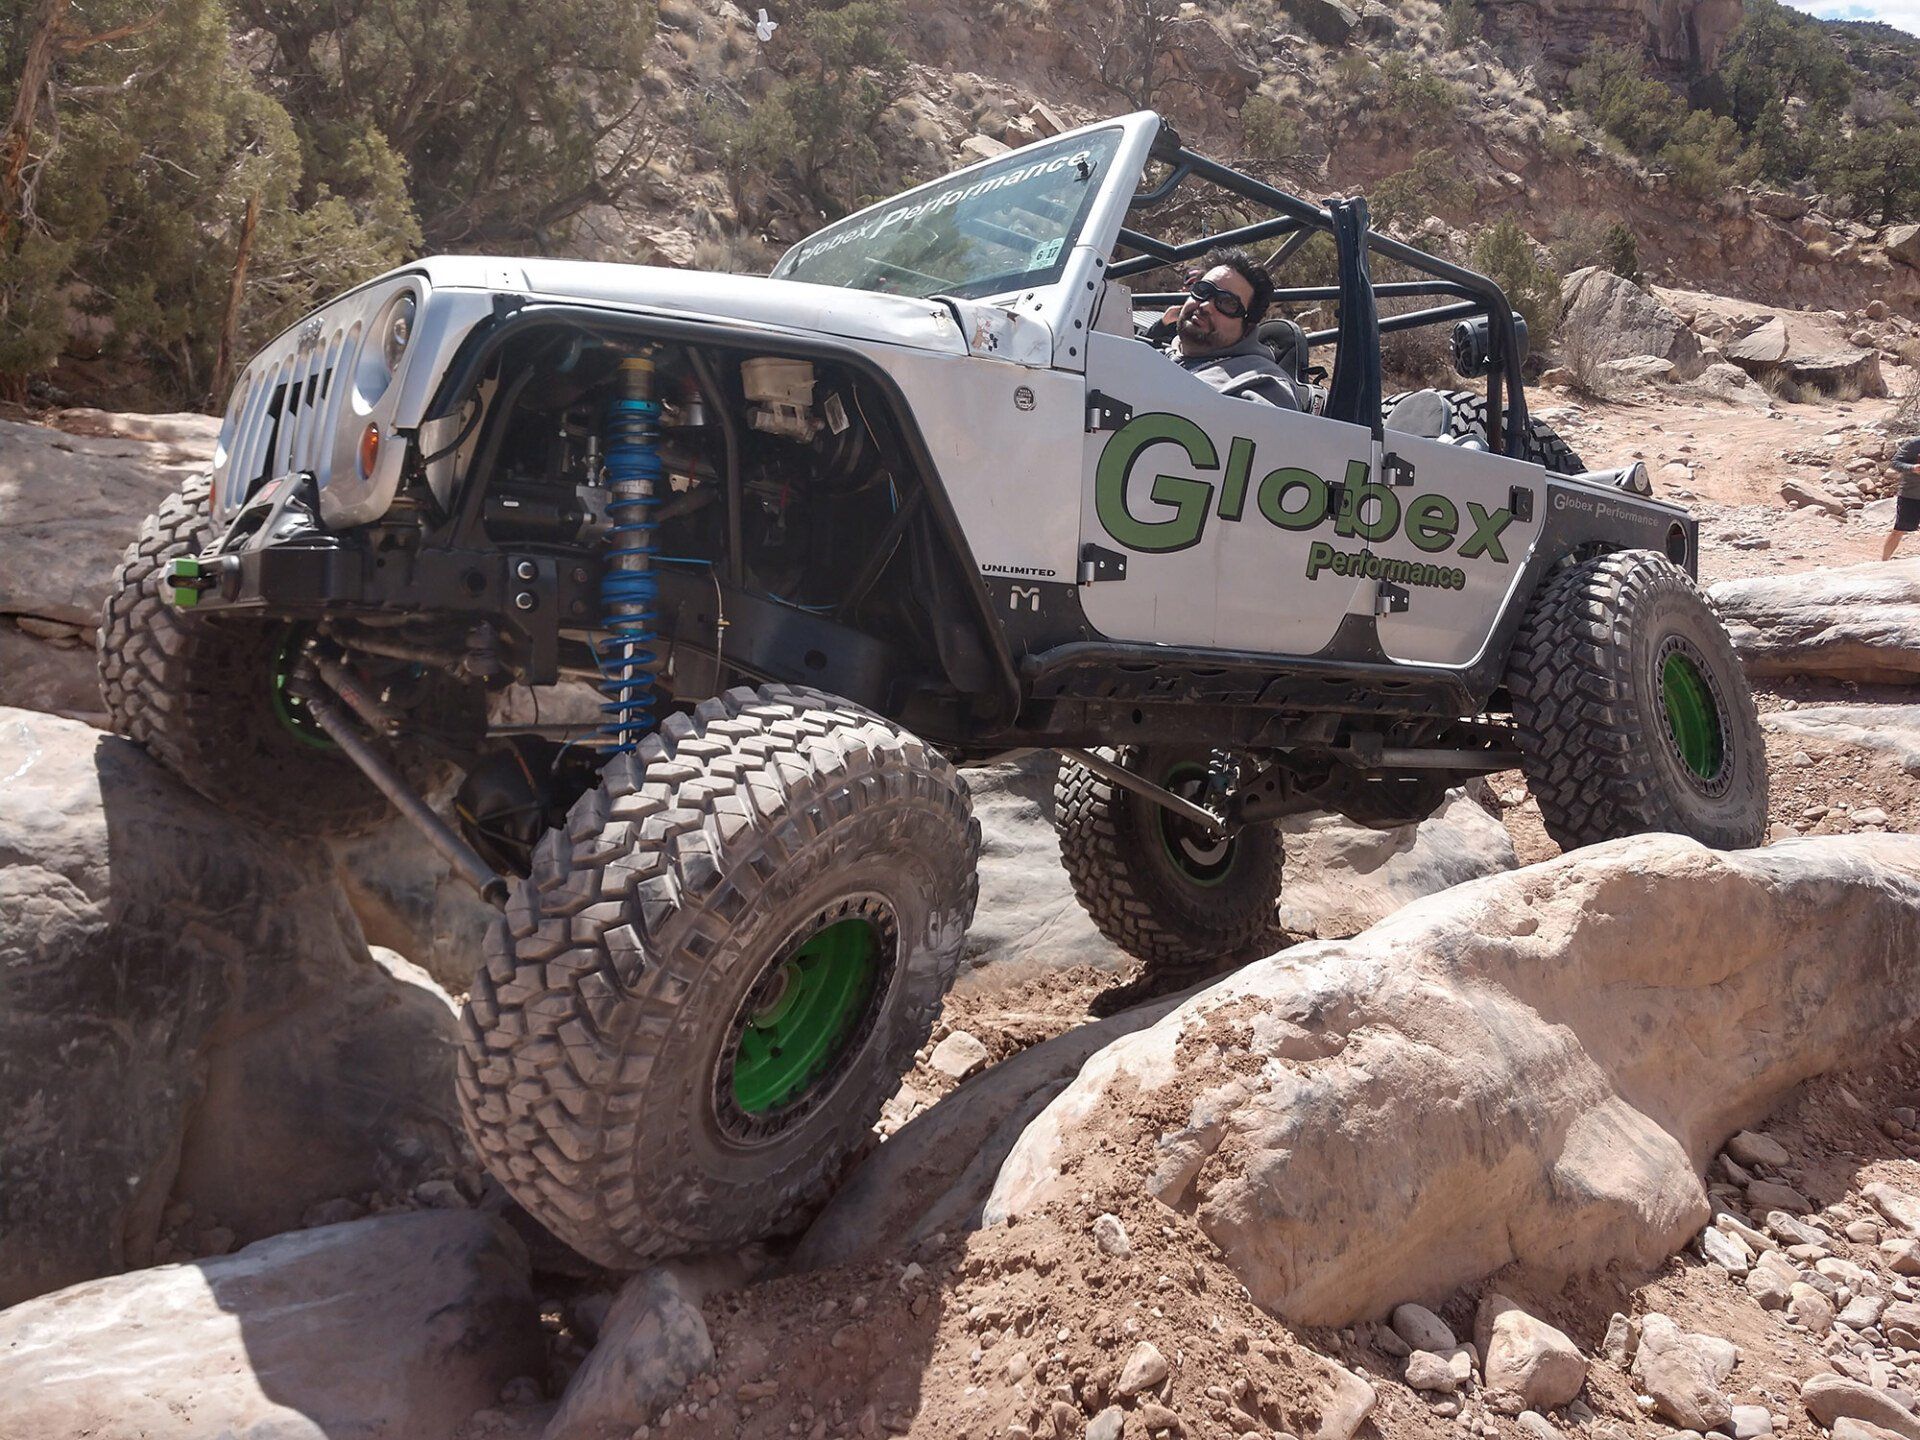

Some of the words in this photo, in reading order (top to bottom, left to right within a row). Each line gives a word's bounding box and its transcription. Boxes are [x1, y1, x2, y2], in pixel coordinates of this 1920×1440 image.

[867, 151, 1091, 240] Performance
[1095, 412, 1514, 563] Globex
[1553, 493, 1593, 512] Globex
[1595, 502, 1660, 527] Performance
[982, 563, 1056, 577] UNLIMITED
[1306, 541, 1466, 590] Performance
